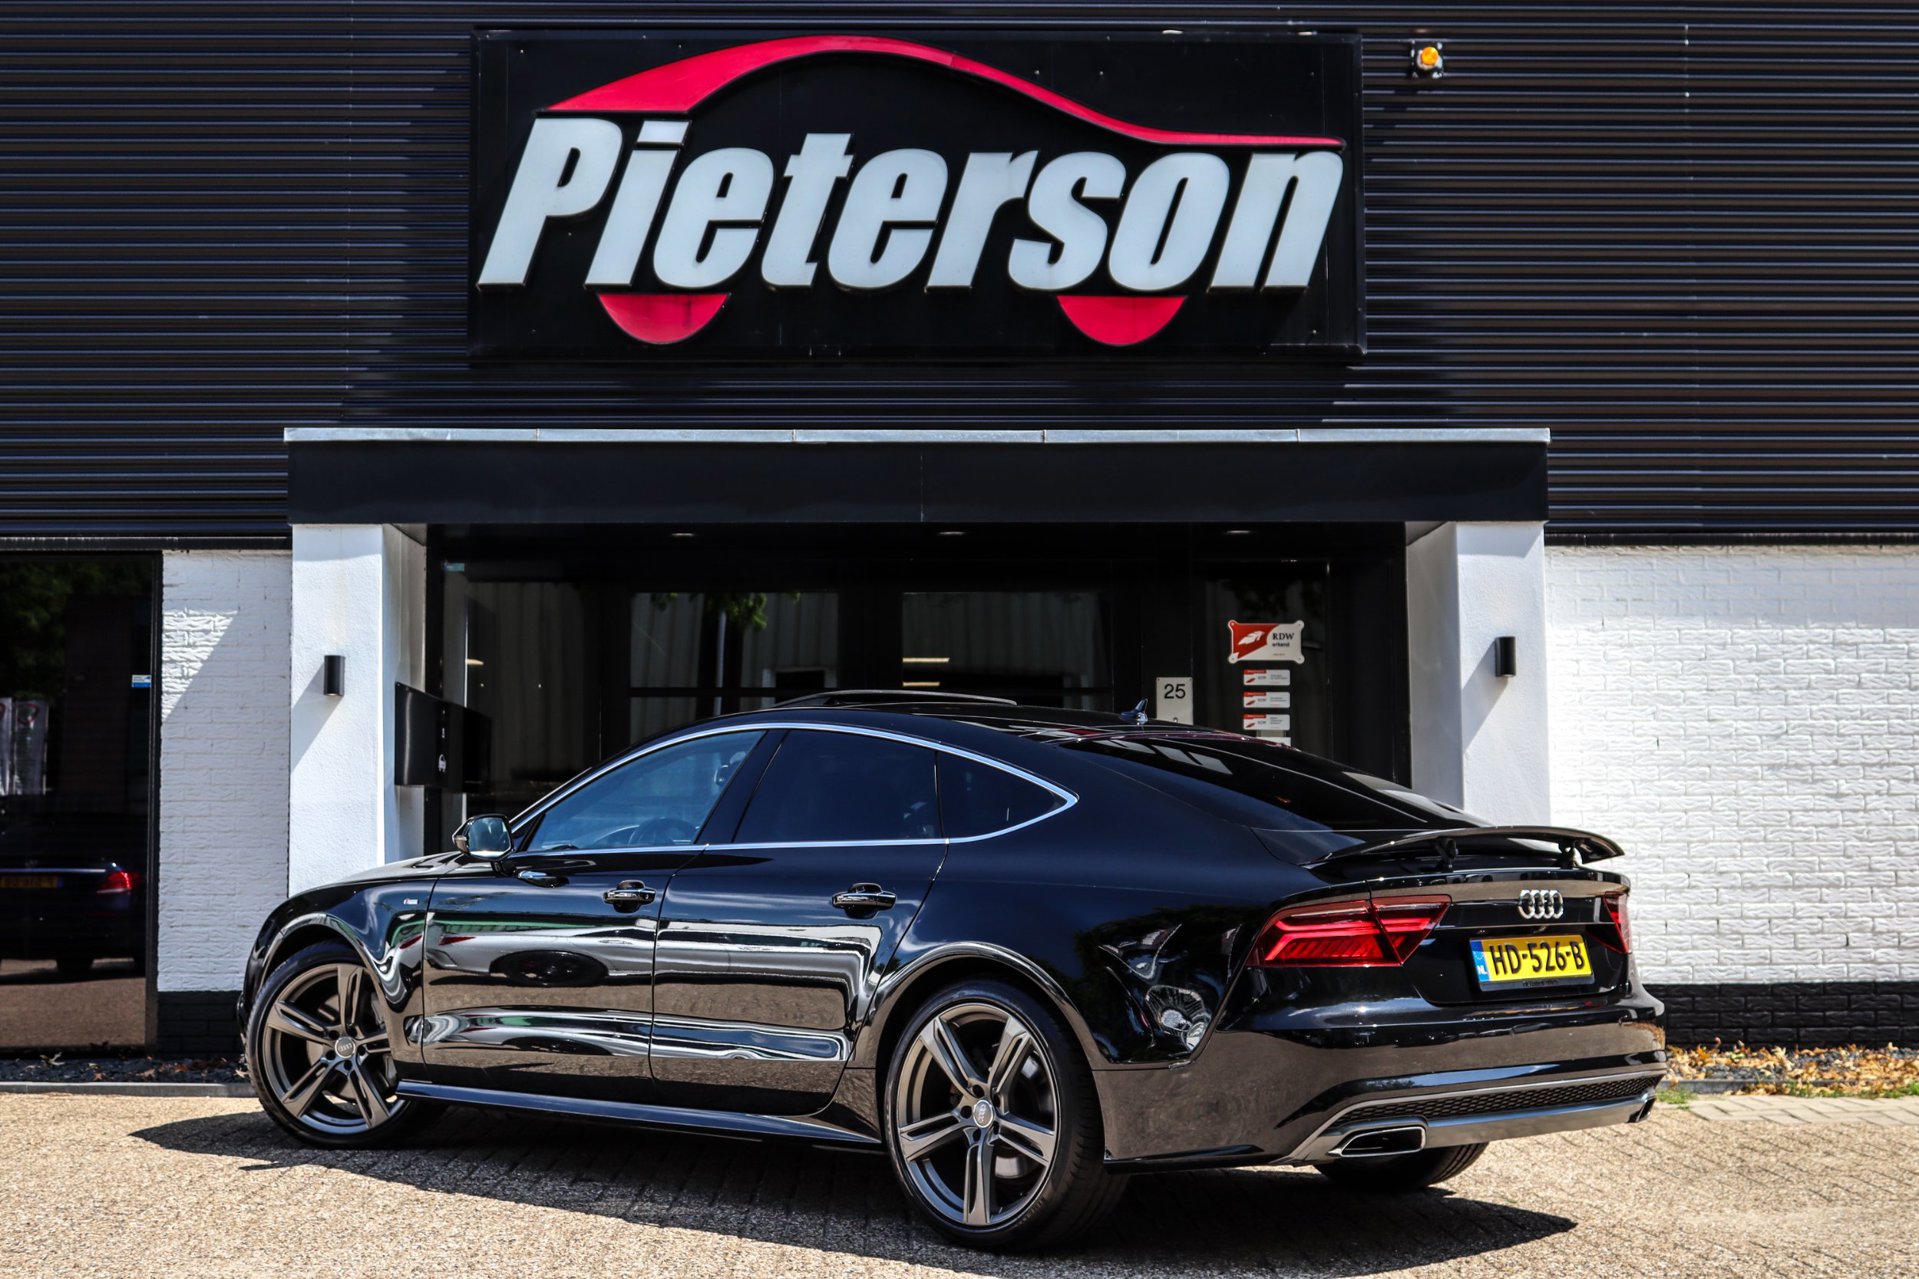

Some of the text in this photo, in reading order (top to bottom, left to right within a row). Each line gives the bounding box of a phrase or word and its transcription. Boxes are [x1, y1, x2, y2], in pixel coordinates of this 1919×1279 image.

[477, 116, 1345, 292] Pieterson
[1272, 632, 1295, 640] RDW
[1164, 683, 1186, 699] 25
[1489, 941, 1585, 976] HD-526-B
[1476, 965, 1488, 975] NL
